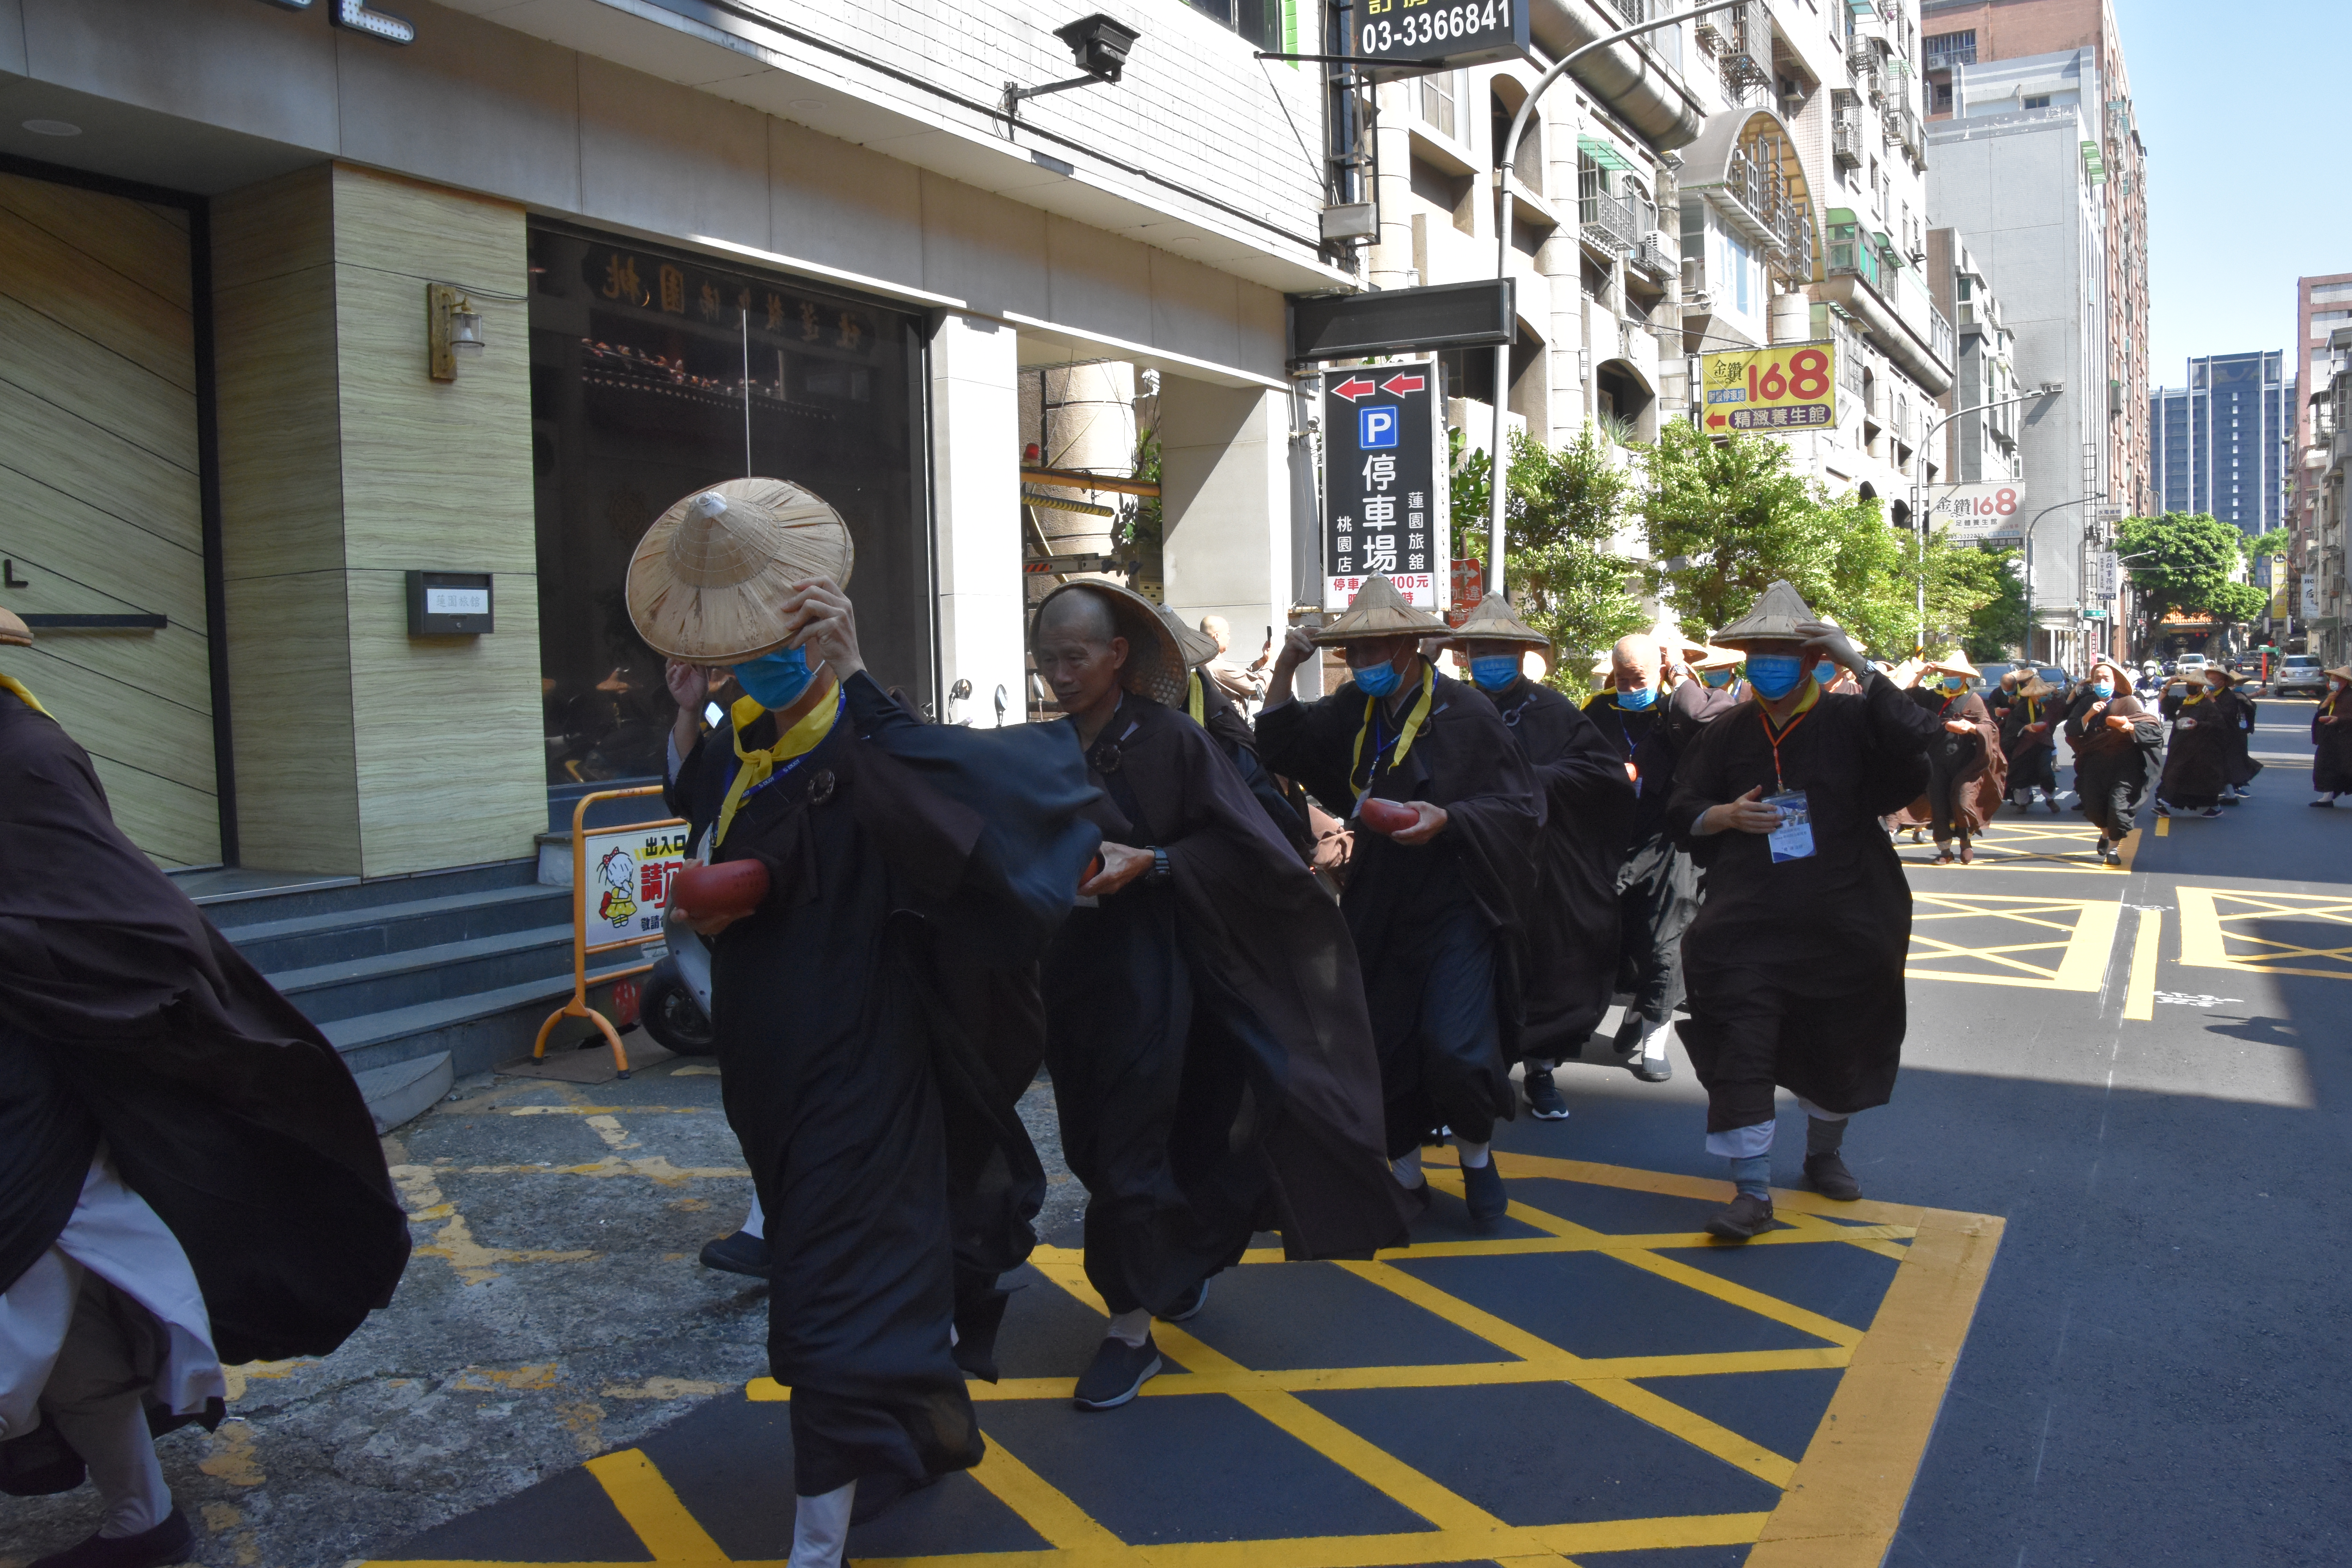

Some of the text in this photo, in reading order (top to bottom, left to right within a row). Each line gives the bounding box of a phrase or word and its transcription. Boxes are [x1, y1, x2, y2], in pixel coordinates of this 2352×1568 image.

[1362, 0, 1510, 53] 03-3366841
[1748, 349, 1830, 402] 168
[1368, 414, 1391, 443] P
[1734, 406, 1826, 428] 精緻養生館
[1362, 454, 1397, 571] 停車場
[1973, 488, 2017, 516] 168
[1337, 516, 1352, 572] 桃園店
[788, 759, 800, 769] ENJOY
[763, 776, 774, 786] ENJOY
[646, 835, 686, 857] 出入口
